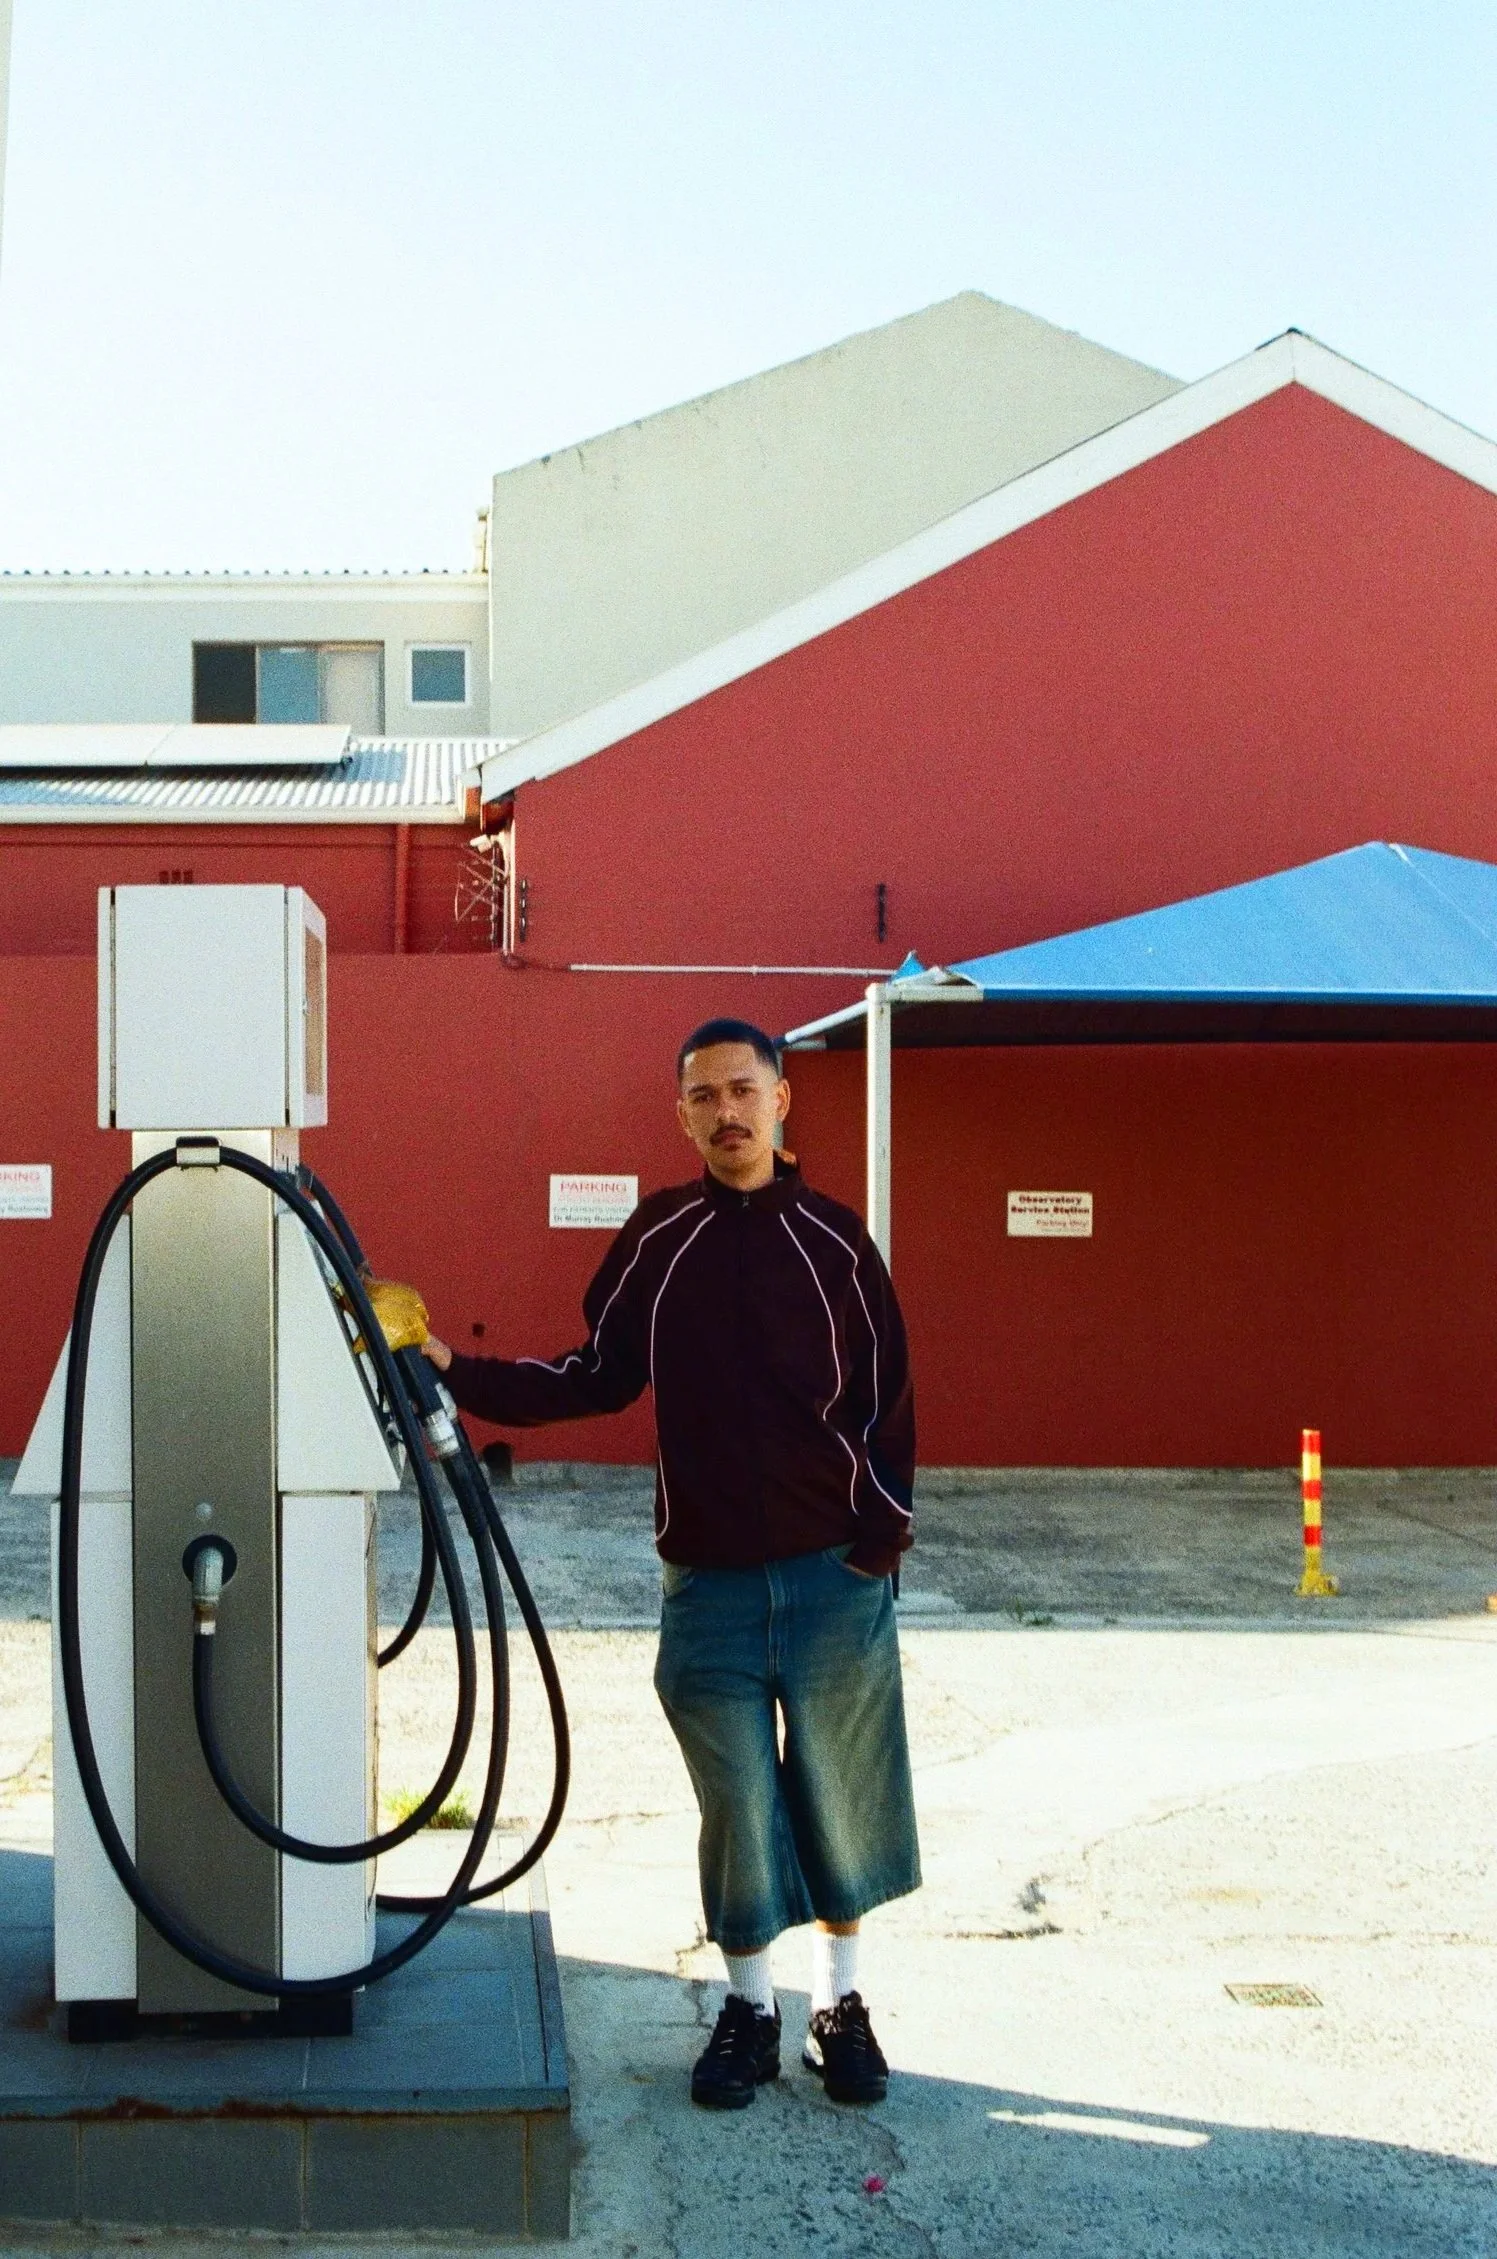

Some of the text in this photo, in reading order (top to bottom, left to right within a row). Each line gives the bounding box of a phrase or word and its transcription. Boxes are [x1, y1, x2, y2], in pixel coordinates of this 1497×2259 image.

[560, 1182, 627, 1193] PARKING
[1019, 1196, 1082, 1205] Observatory
[1011, 1206, 1090, 1214] Service Station
